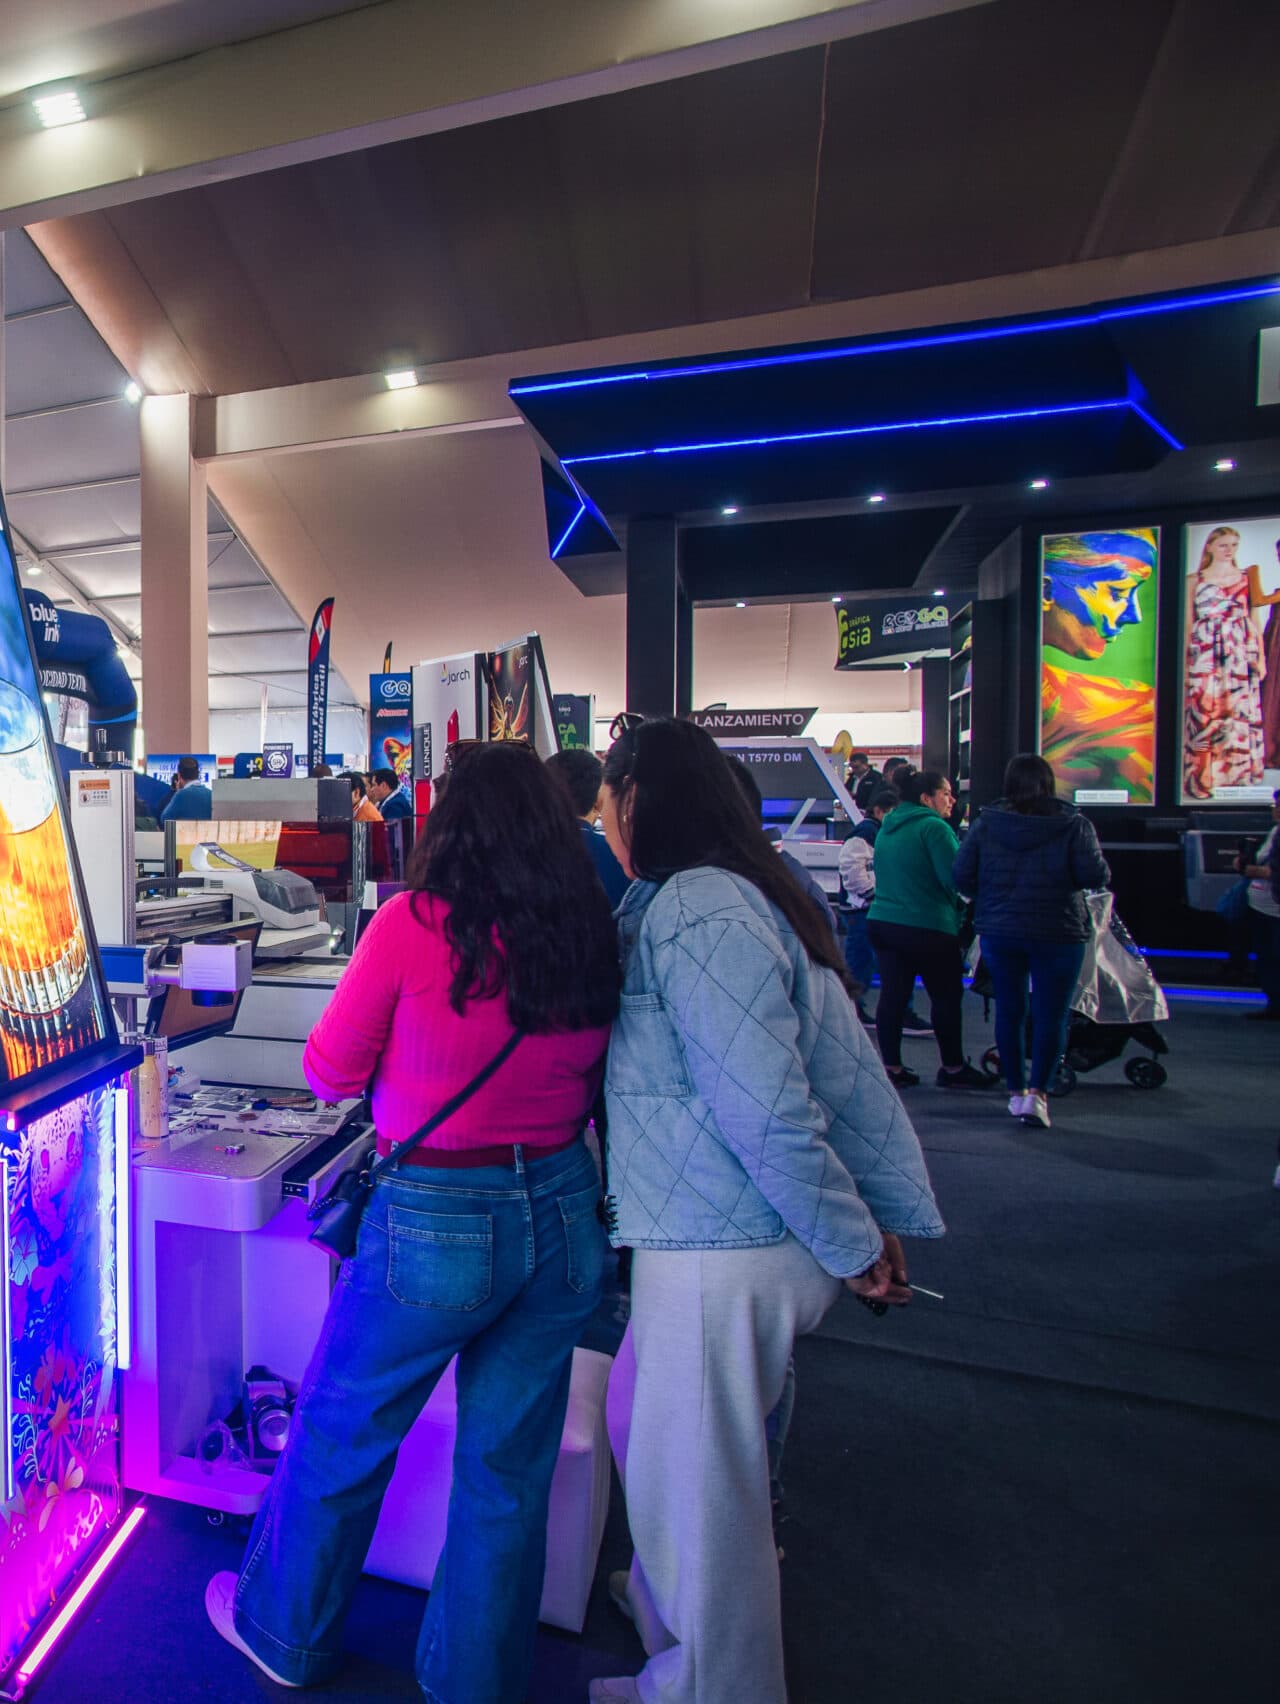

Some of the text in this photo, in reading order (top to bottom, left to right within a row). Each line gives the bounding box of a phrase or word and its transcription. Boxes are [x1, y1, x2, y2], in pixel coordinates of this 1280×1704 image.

[29, 603, 58, 623] blue
[44, 622, 60, 643] ink
[447, 668, 471, 686] jarch
[694, 713, 804, 727] LANZAMIENTO
[423, 725, 431, 776] CLINIQUE
[784, 753, 802, 762] DM
